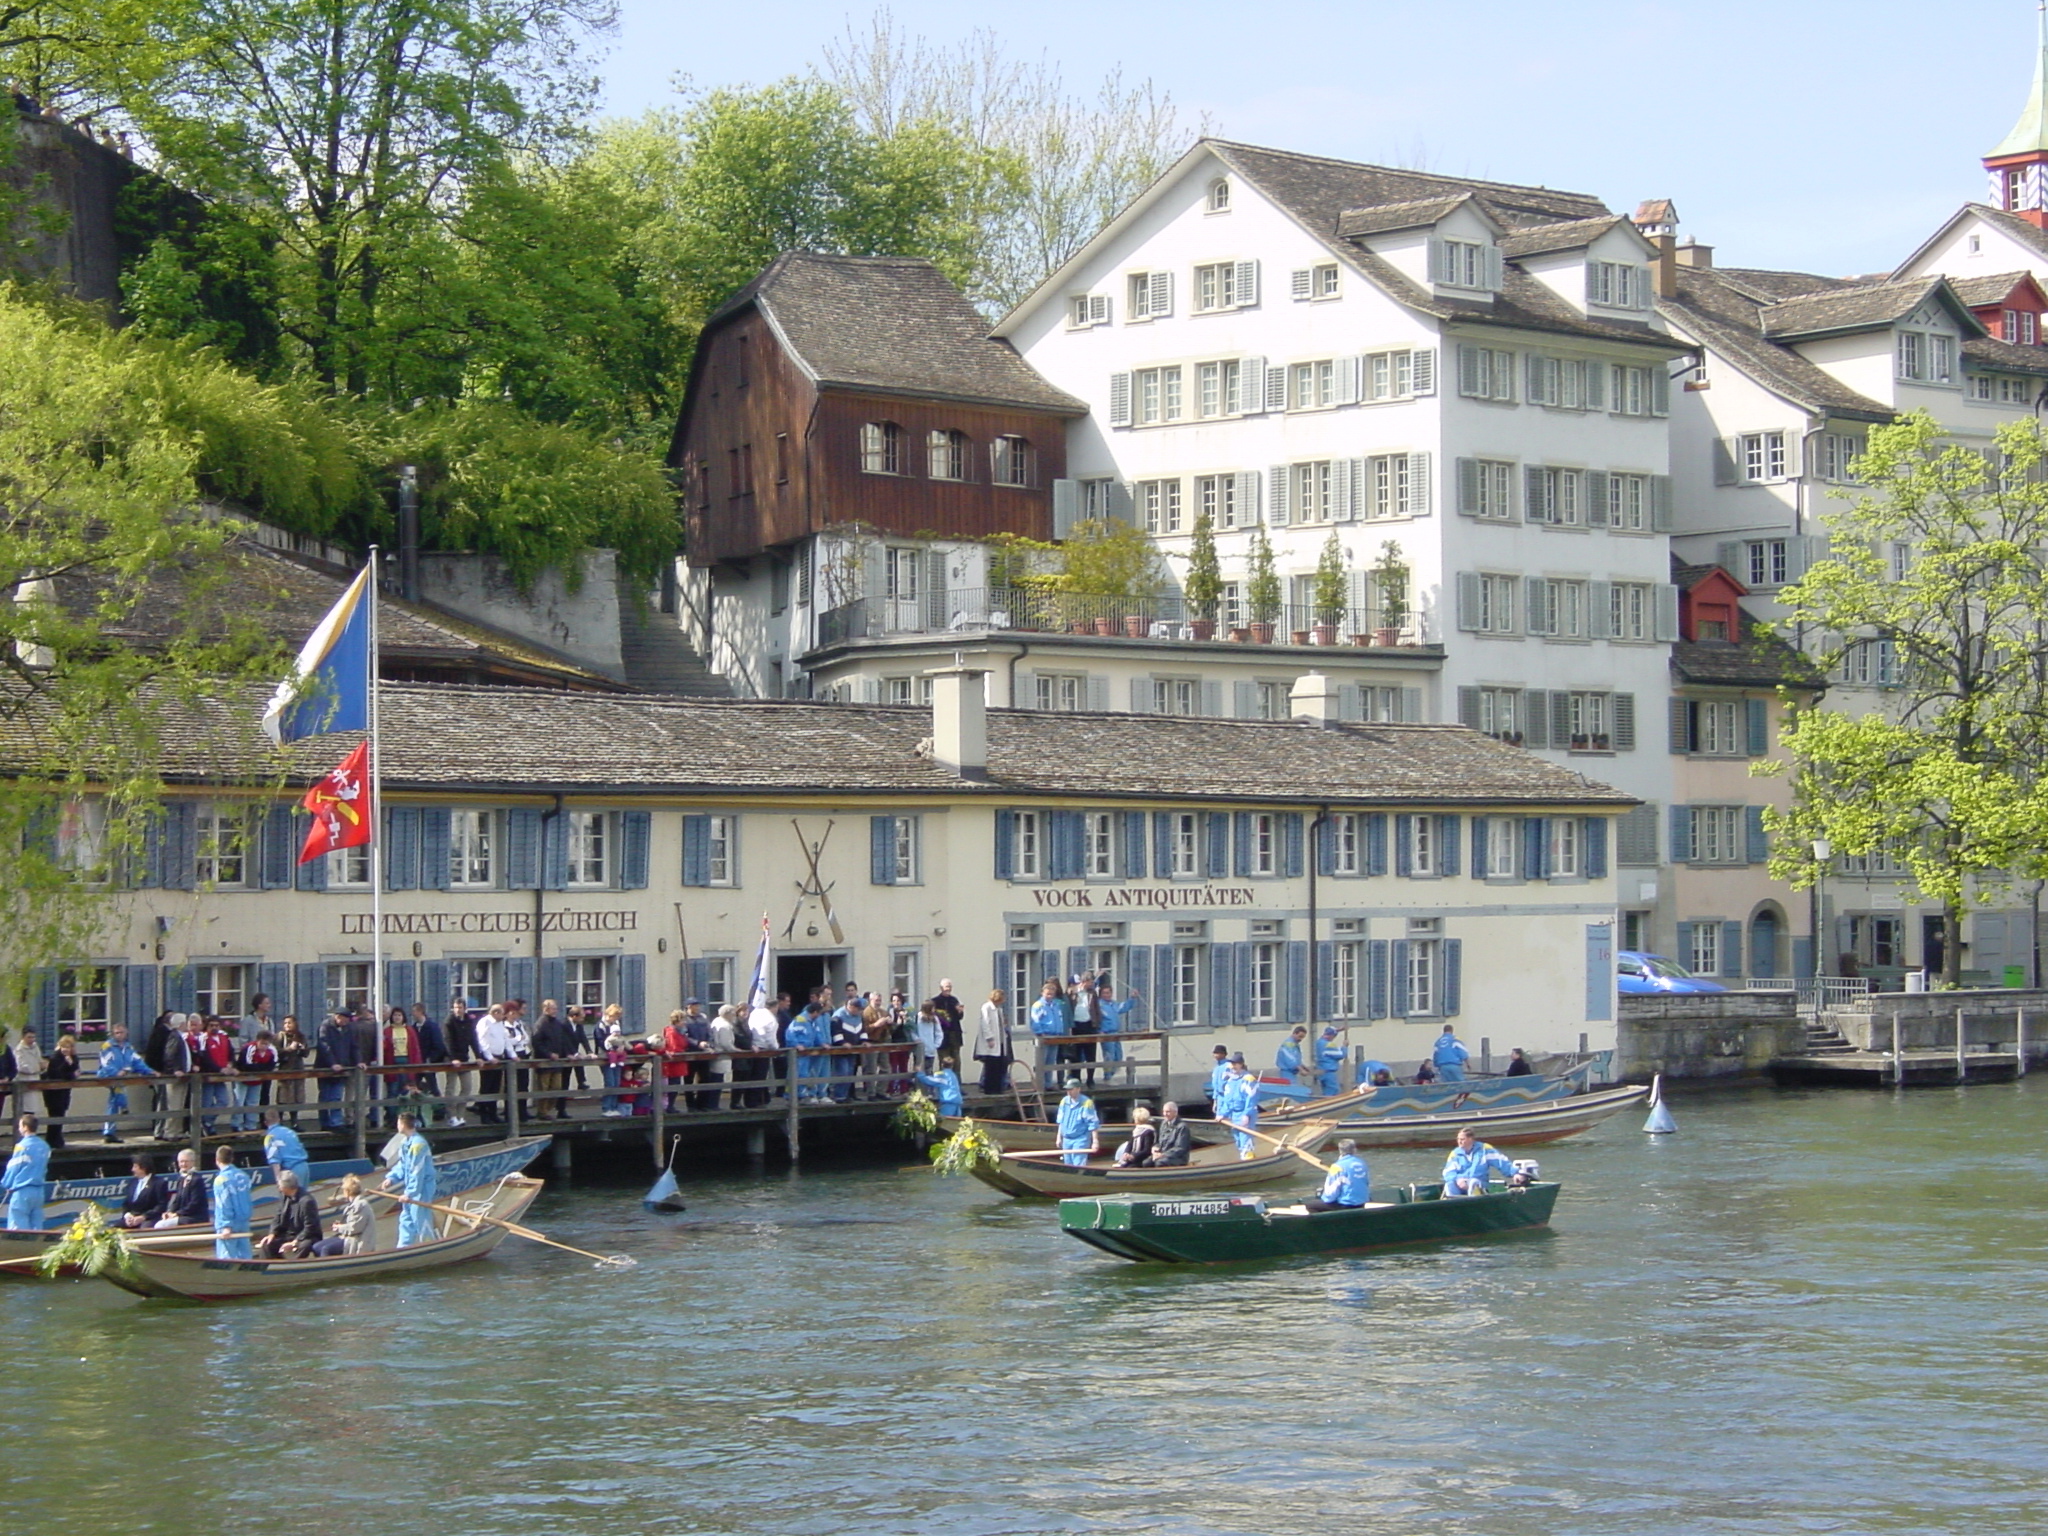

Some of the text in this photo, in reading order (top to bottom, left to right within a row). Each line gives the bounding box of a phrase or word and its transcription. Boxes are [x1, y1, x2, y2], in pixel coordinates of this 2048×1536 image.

[1033, 885, 1255, 909] VOCK ANTIQUITÄTEN
[340, 907, 637, 935] LIMMAT-CLUB ZÜRICH
